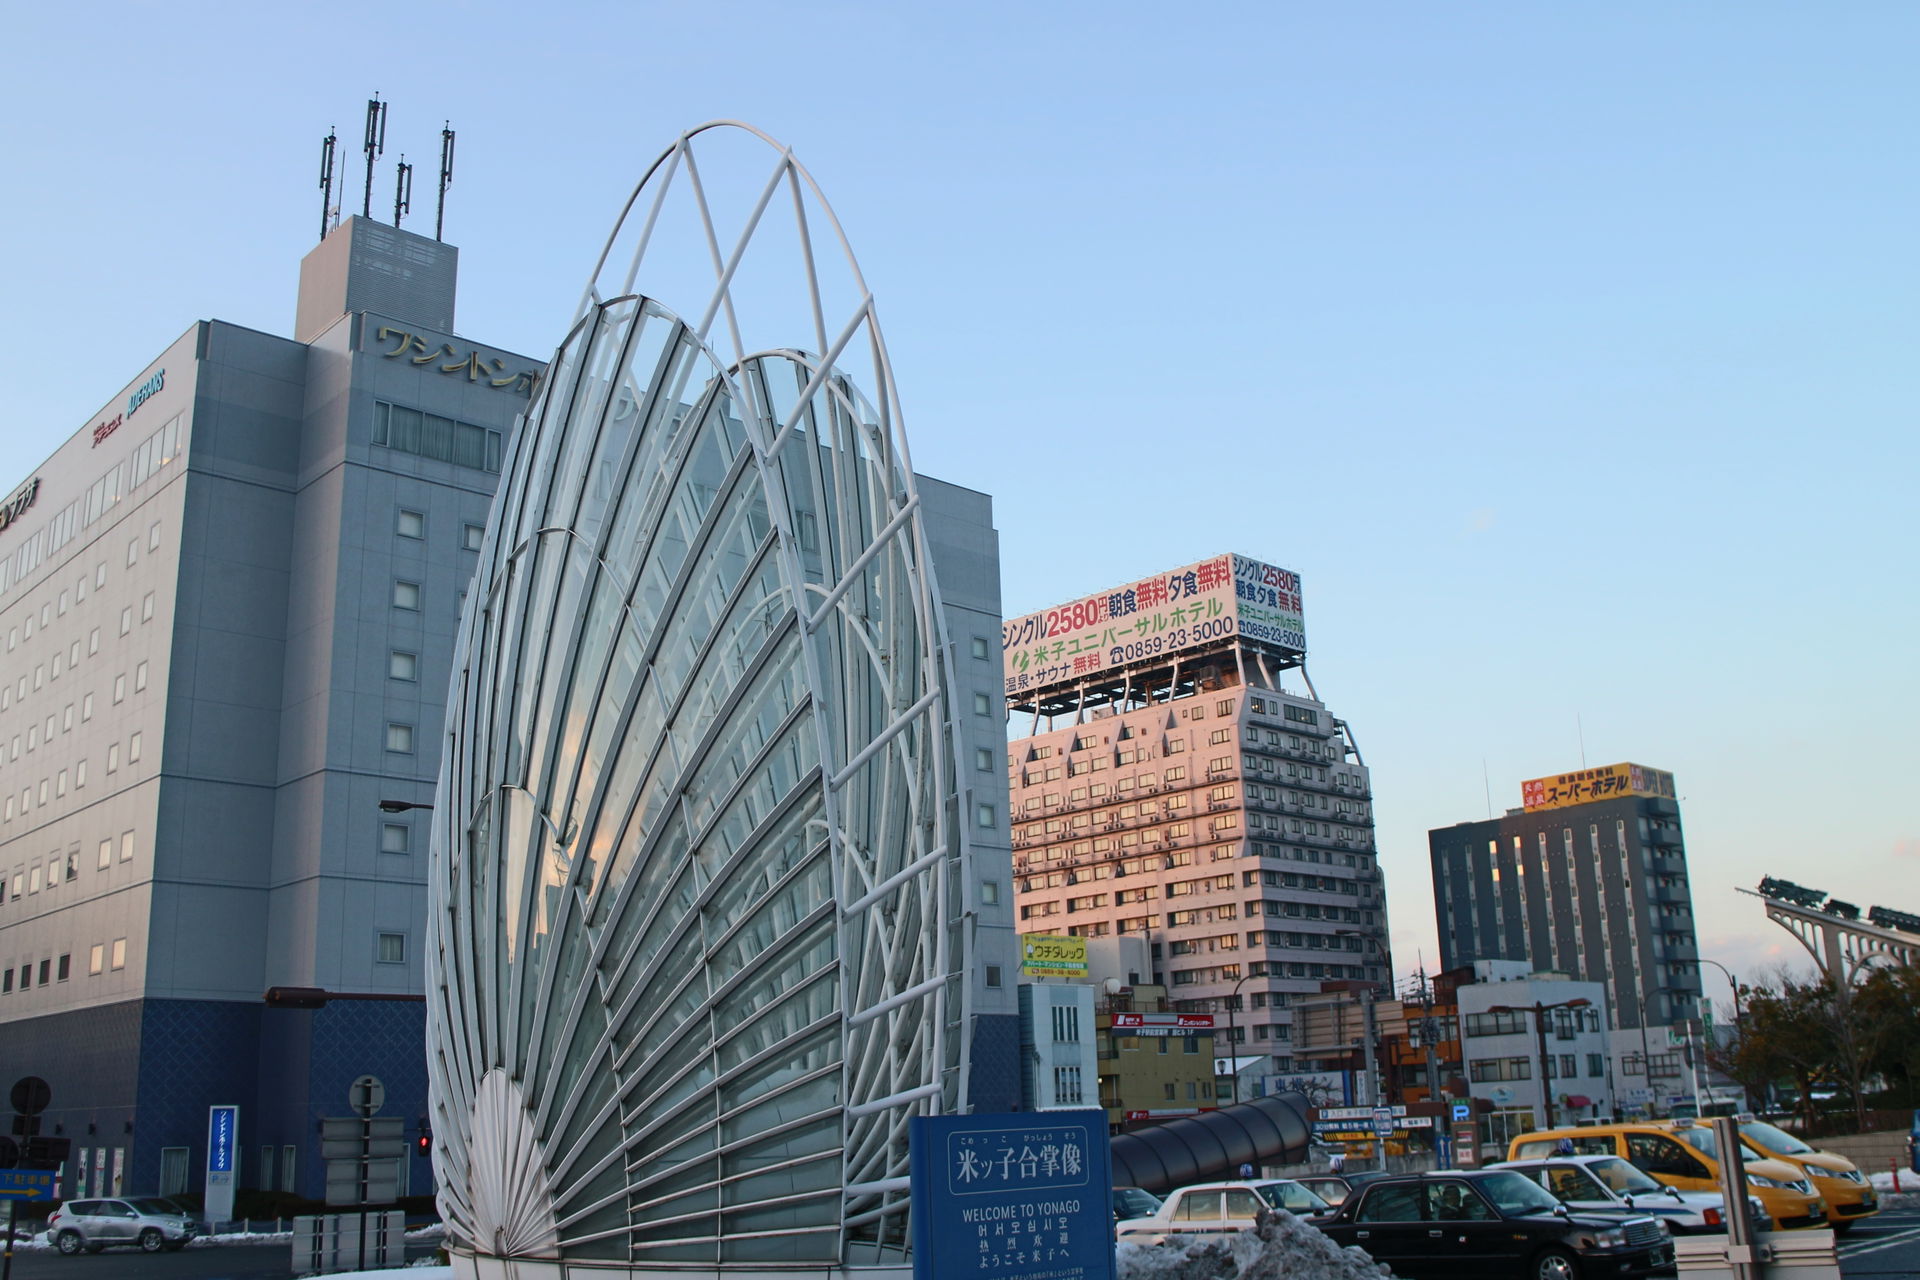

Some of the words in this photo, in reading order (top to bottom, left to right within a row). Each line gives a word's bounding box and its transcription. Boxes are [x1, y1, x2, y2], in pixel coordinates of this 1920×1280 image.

[1125, 616, 1233, 660] 0859-23-5000
[1246, 621, 1305, 649] 0859-23-5000
[1547, 775, 1629, 804] スーパーホテル
[1035, 945, 1084, 959] ウチダレック
[1453, 1104, 1470, 1121] P
[956, 1143, 1081, 1183] 米ッ子合掌像
[963, 1205, 1016, 1222] WELCOME
[1020, 1203, 1034, 1217] TO
[1038, 1200, 1080, 1216] YONAGO
